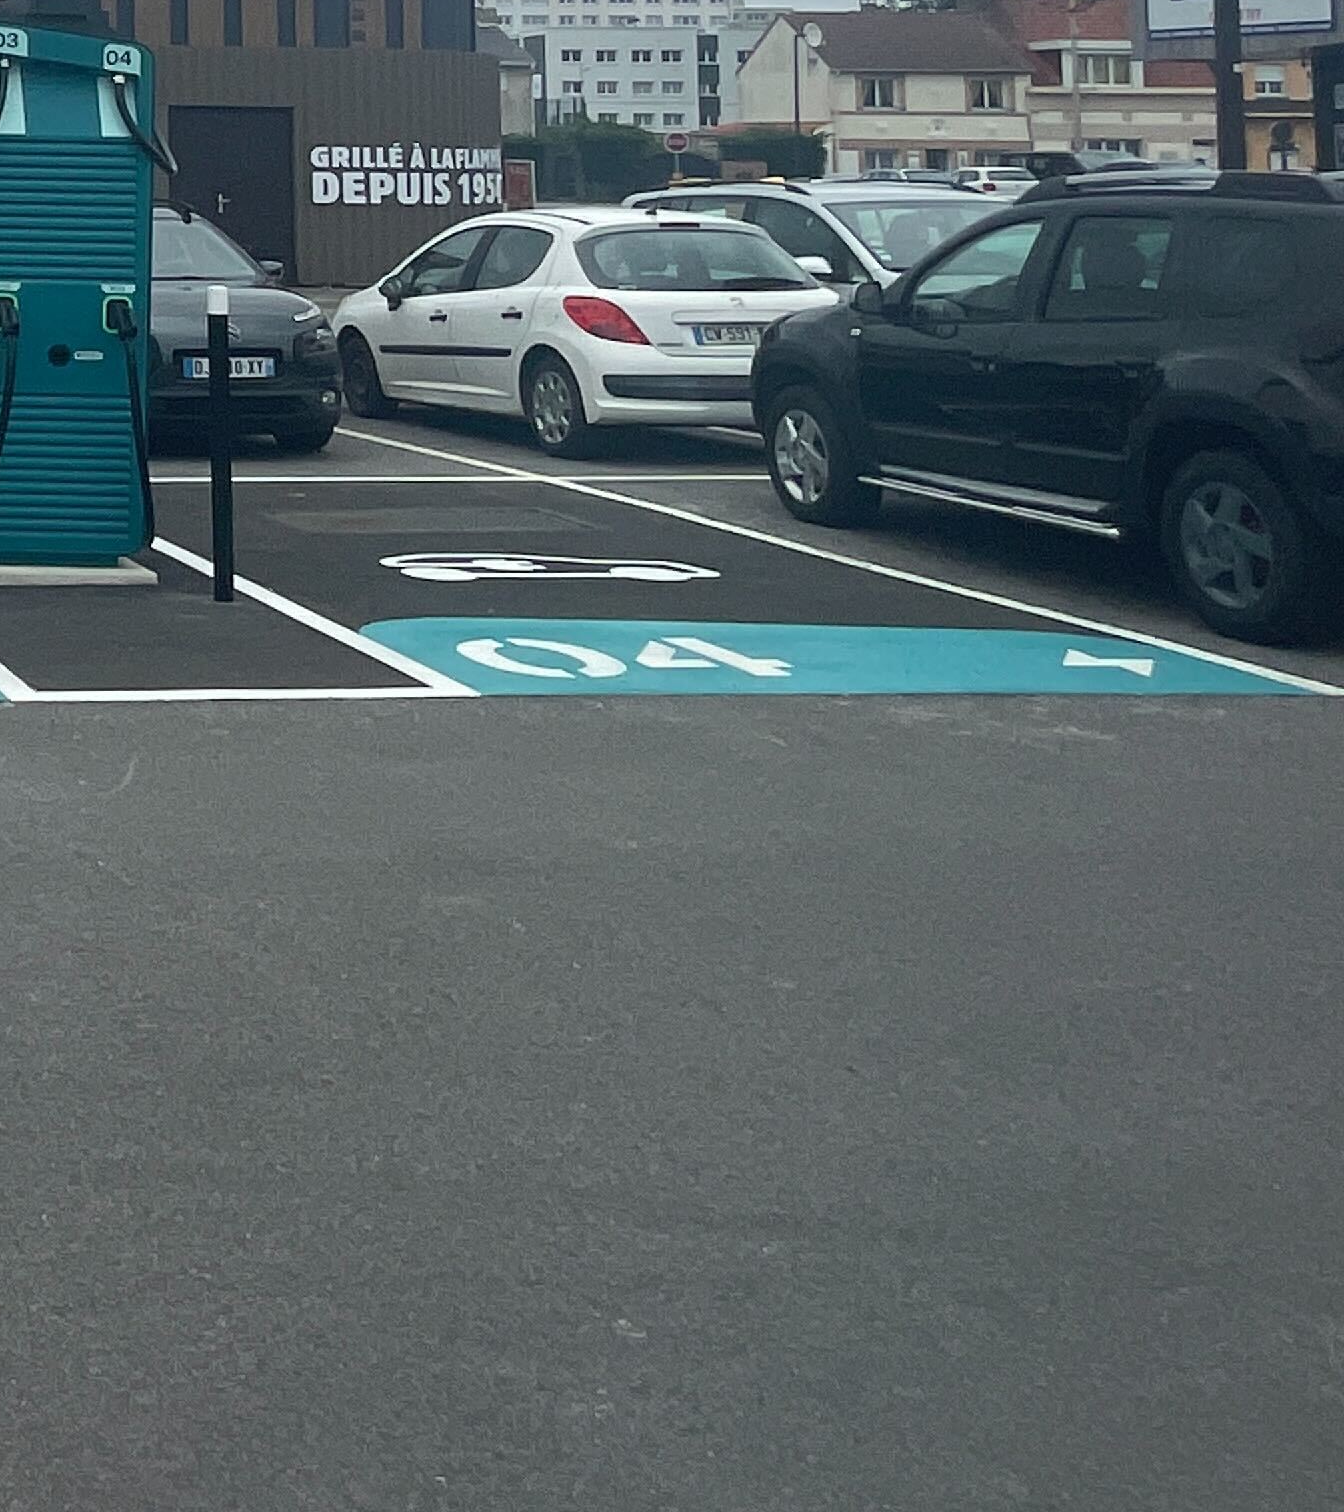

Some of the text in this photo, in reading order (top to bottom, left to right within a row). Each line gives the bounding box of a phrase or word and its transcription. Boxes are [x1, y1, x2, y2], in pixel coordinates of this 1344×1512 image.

[106, 50, 132, 66] 04
[311, 143, 403, 169] GRILLÉ
[411, 143, 426, 169] À
[312, 172, 452, 205] DEPUIS
[455, 636, 796, 679] 04
